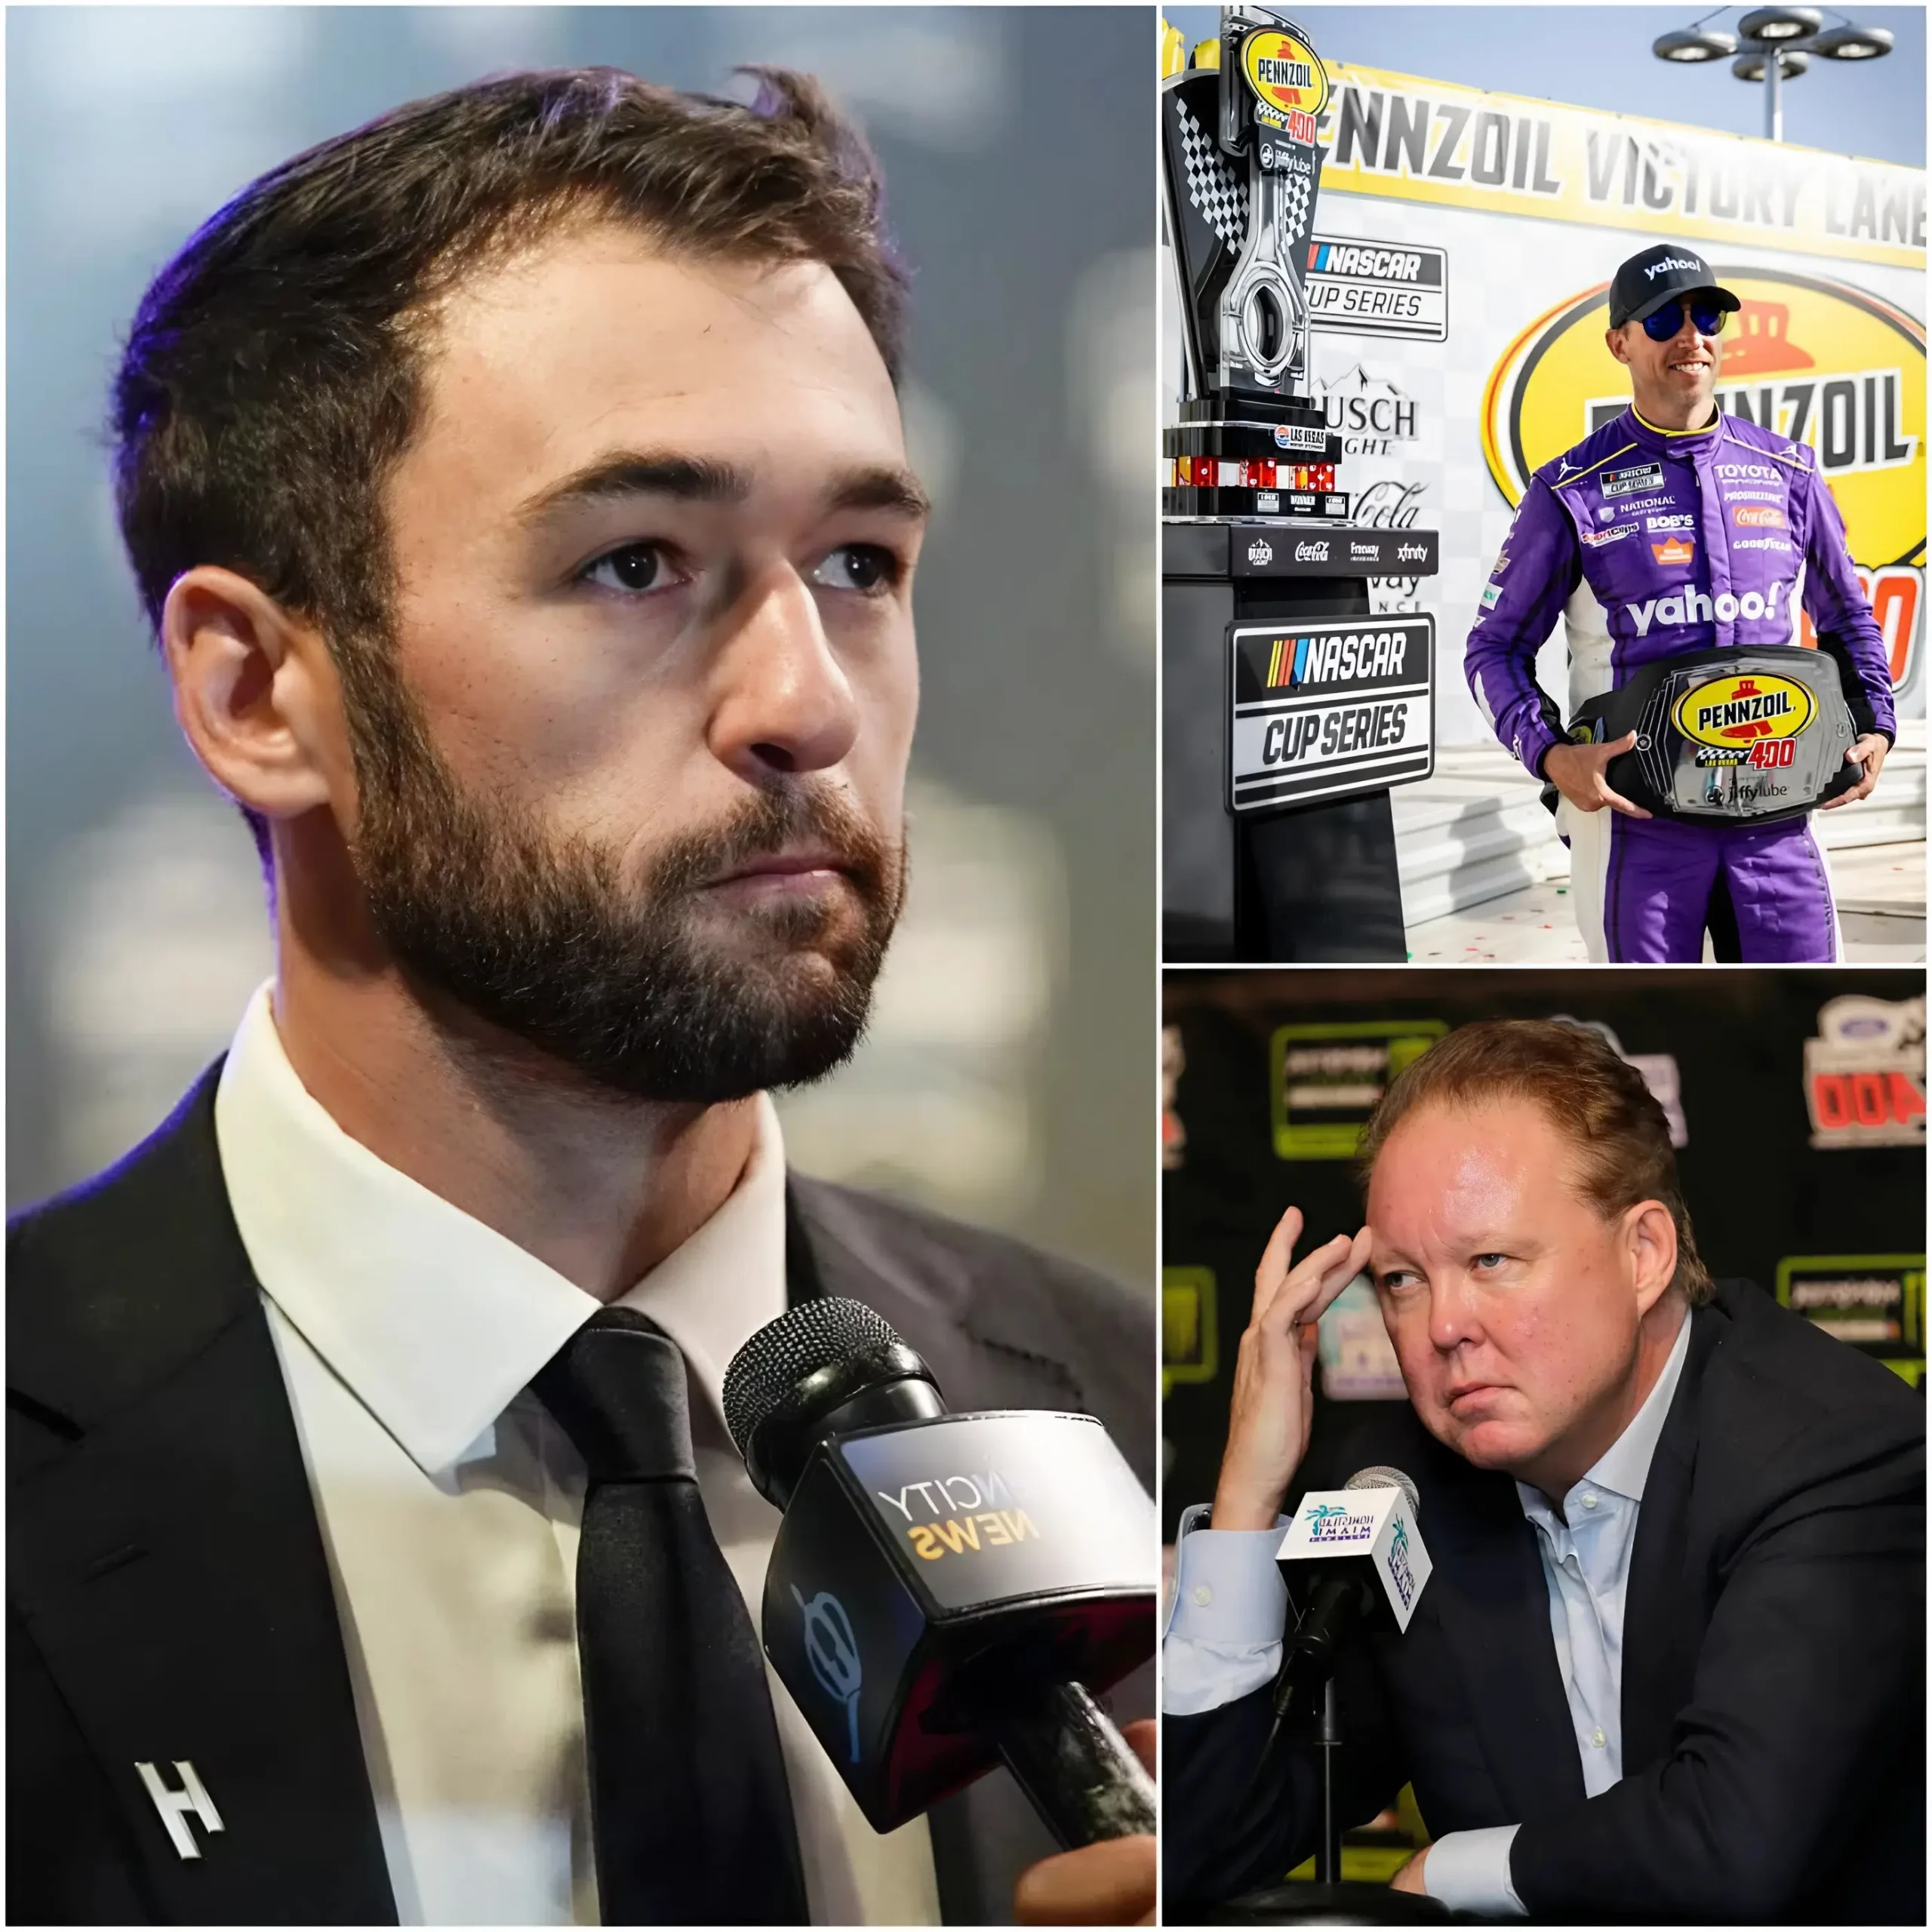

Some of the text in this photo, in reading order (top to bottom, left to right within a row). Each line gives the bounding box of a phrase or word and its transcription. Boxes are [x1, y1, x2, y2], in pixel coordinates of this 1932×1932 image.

[1258, 58, 1312, 88] PENNZOIL
[1314, 84, 1561, 196] NNZOIL
[1586, 128, 1808, 227] VICTORY
[1325, 245, 1422, 281] NASCAR
[1304, 285, 1422, 316] UP SERIES
[1312, 395, 1415, 436] USCH
[1592, 375, 1911, 469] NZOIL
[1345, 438, 1392, 456] GHT
[1714, 464, 1783, 481] TOYOTA
[1620, 495, 1675, 512] NATIONAL
[1646, 514, 1694, 529] BOB'S
[1626, 581, 1783, 637] yahoo!
[1303, 632, 1407, 684] NASCAR
[1698, 691, 1792, 731] PENNZOIL
[1263, 703, 1407, 764] CUP SERIES
[1748, 738, 1796, 770] 400
